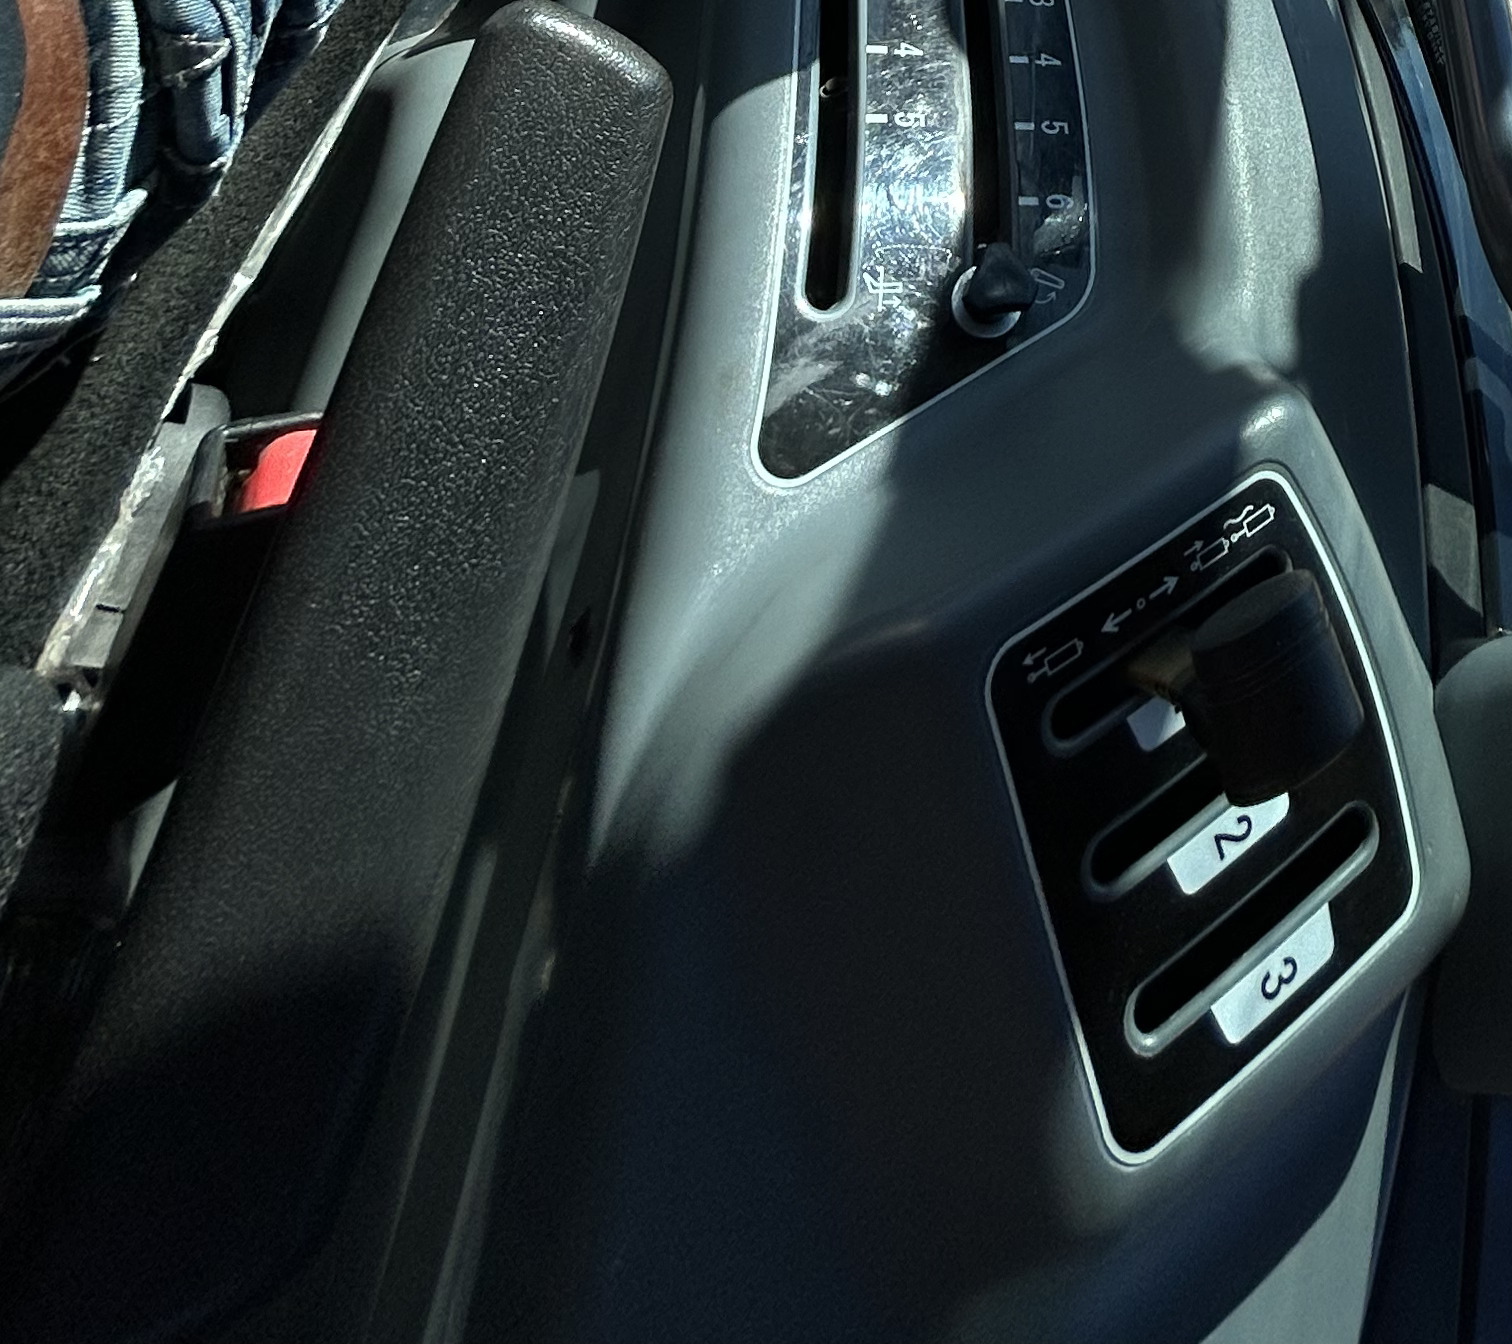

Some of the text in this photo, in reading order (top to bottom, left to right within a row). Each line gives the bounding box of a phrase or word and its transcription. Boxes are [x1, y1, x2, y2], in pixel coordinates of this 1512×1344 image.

[894, 42, 924, 57] 4
[1034, 53, 1062, 67] 4
[894, 111, 926, 127] 5
[1040, 120, 1069, 135] 5
[1045, 193, 1074, 209] 6
[1214, 814, 1253, 861] 2
[1261, 956, 1298, 1000] 3
